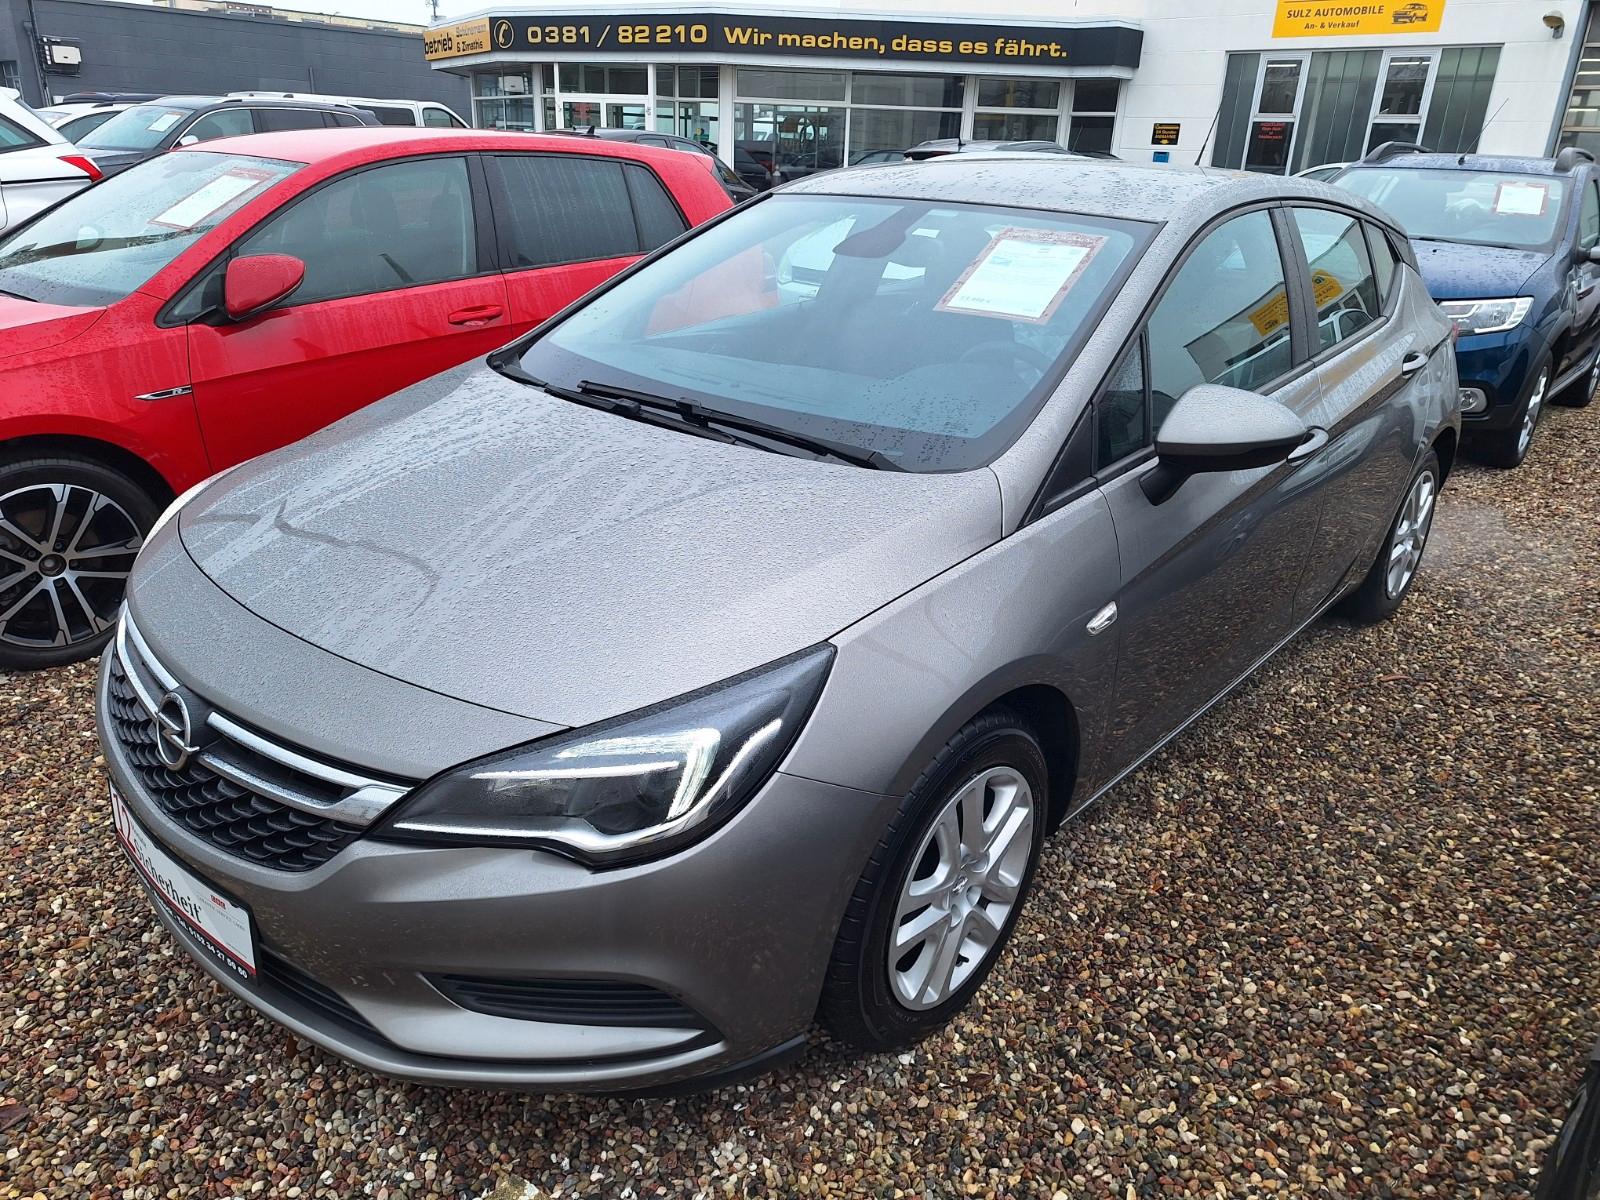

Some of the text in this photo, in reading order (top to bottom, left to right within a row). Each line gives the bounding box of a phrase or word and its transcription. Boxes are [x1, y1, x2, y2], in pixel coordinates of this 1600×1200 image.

[1287, 5, 1385, 19] SULZ AUTOMOBILE
[1304, 22, 1319, 30] An-
[1328, 20, 1360, 29] Verkauf
[527, 26, 590, 44] 0381
[724, 27, 1068, 58] Wir machen, dass es fährt.
